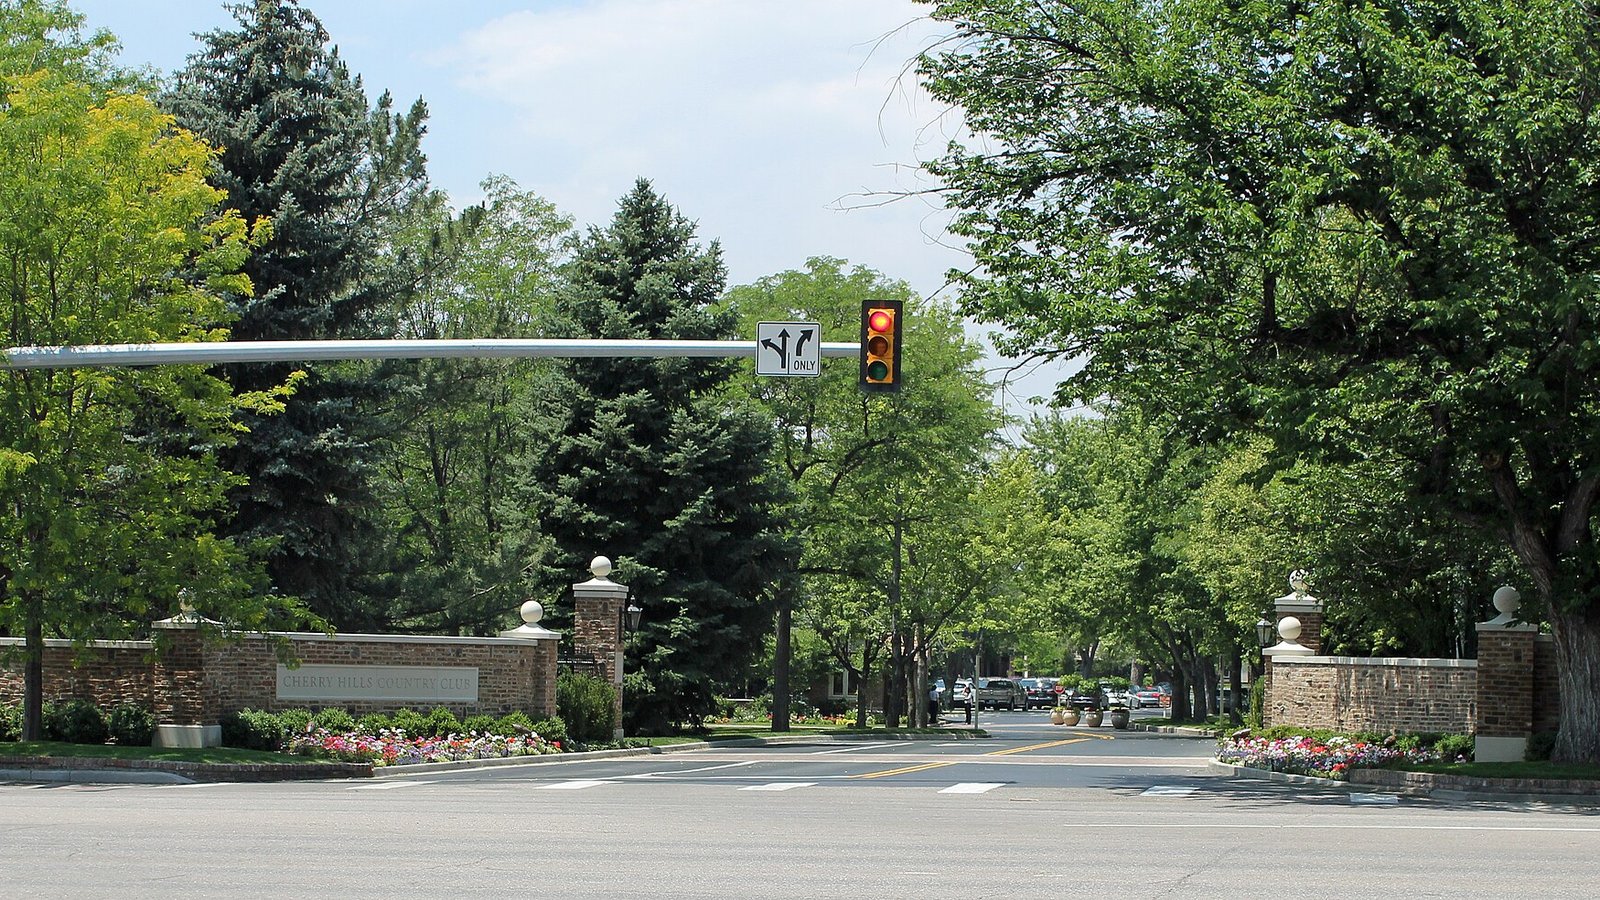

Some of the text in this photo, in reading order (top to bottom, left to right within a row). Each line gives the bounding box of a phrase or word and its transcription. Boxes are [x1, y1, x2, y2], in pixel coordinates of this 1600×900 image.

[794, 360, 816, 371] ONLY
[283, 676, 471, 690] CHERRY HILLS COUNTRY CLUB
